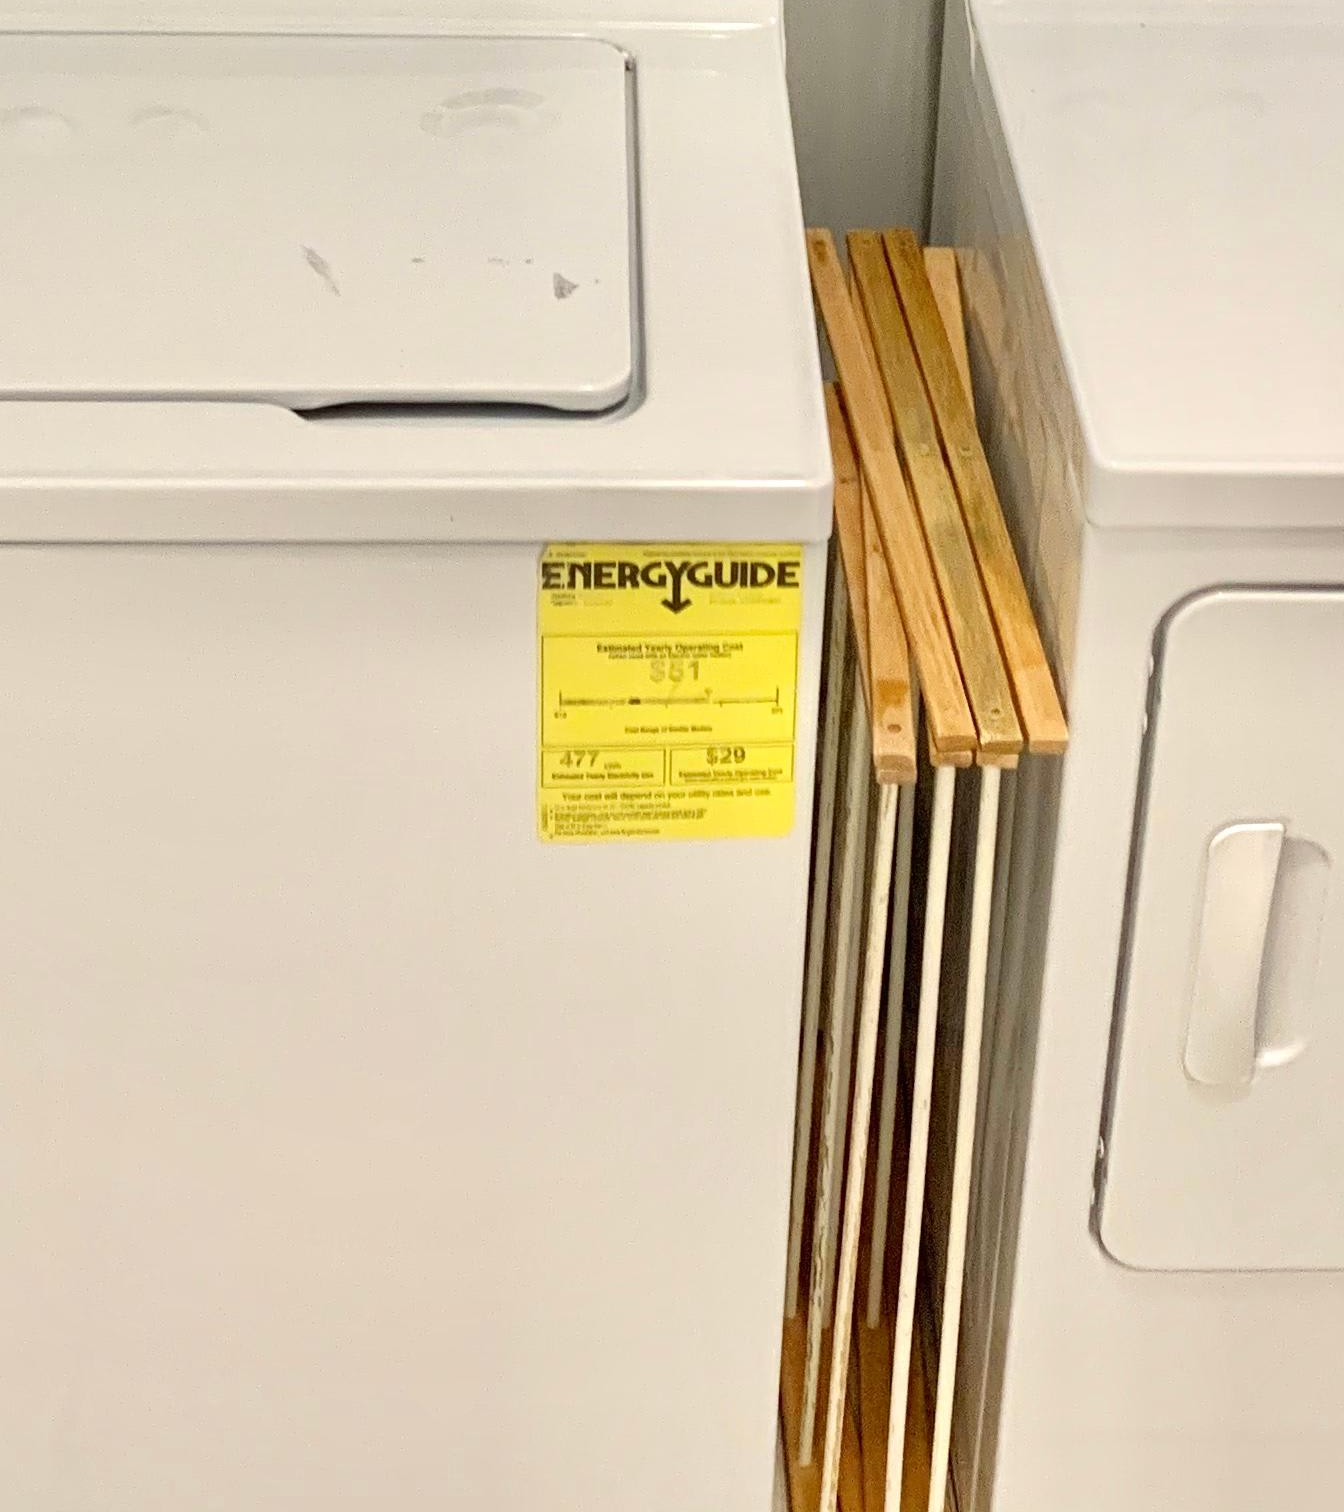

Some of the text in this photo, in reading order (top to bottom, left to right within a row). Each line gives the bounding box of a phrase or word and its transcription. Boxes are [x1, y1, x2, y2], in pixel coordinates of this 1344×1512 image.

[542, 560, 801, 590] ENERGYGUIDE
[597, 644, 643, 653] Estimated
[645, 644, 673, 654] Yearly
[675, 642, 720, 654] Operating
[560, 749, 600, 769] 477
[706, 745, 746, 765] $29
[620, 791, 652, 802] depend
